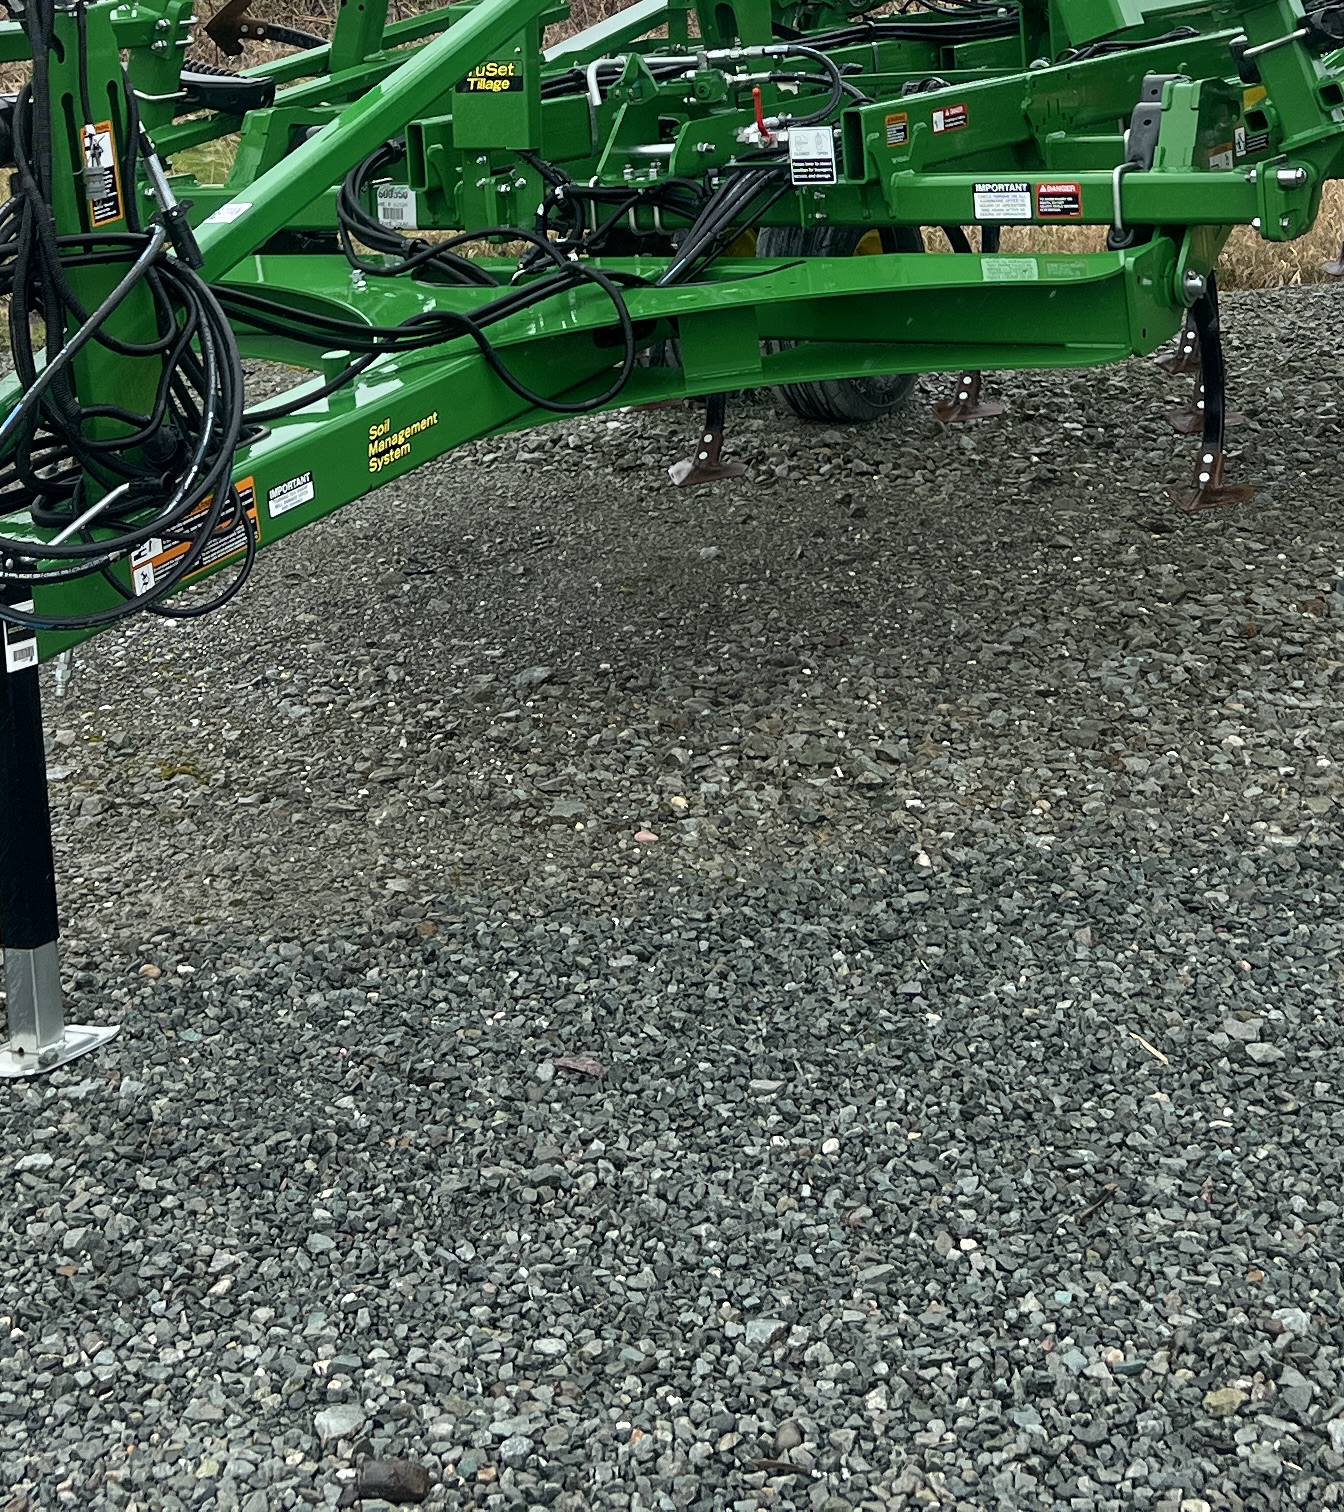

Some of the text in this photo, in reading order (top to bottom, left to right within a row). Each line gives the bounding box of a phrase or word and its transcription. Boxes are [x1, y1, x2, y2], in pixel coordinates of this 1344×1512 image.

[468, 62, 515, 77] uSet
[466, 77, 511, 92] Tillage
[975, 183, 1028, 192] IMPORTANT
[368, 417, 391, 441] Soil
[368, 410, 439, 458] Management
[368, 442, 411, 473] System
[269, 471, 311, 499] IMPORTANT
